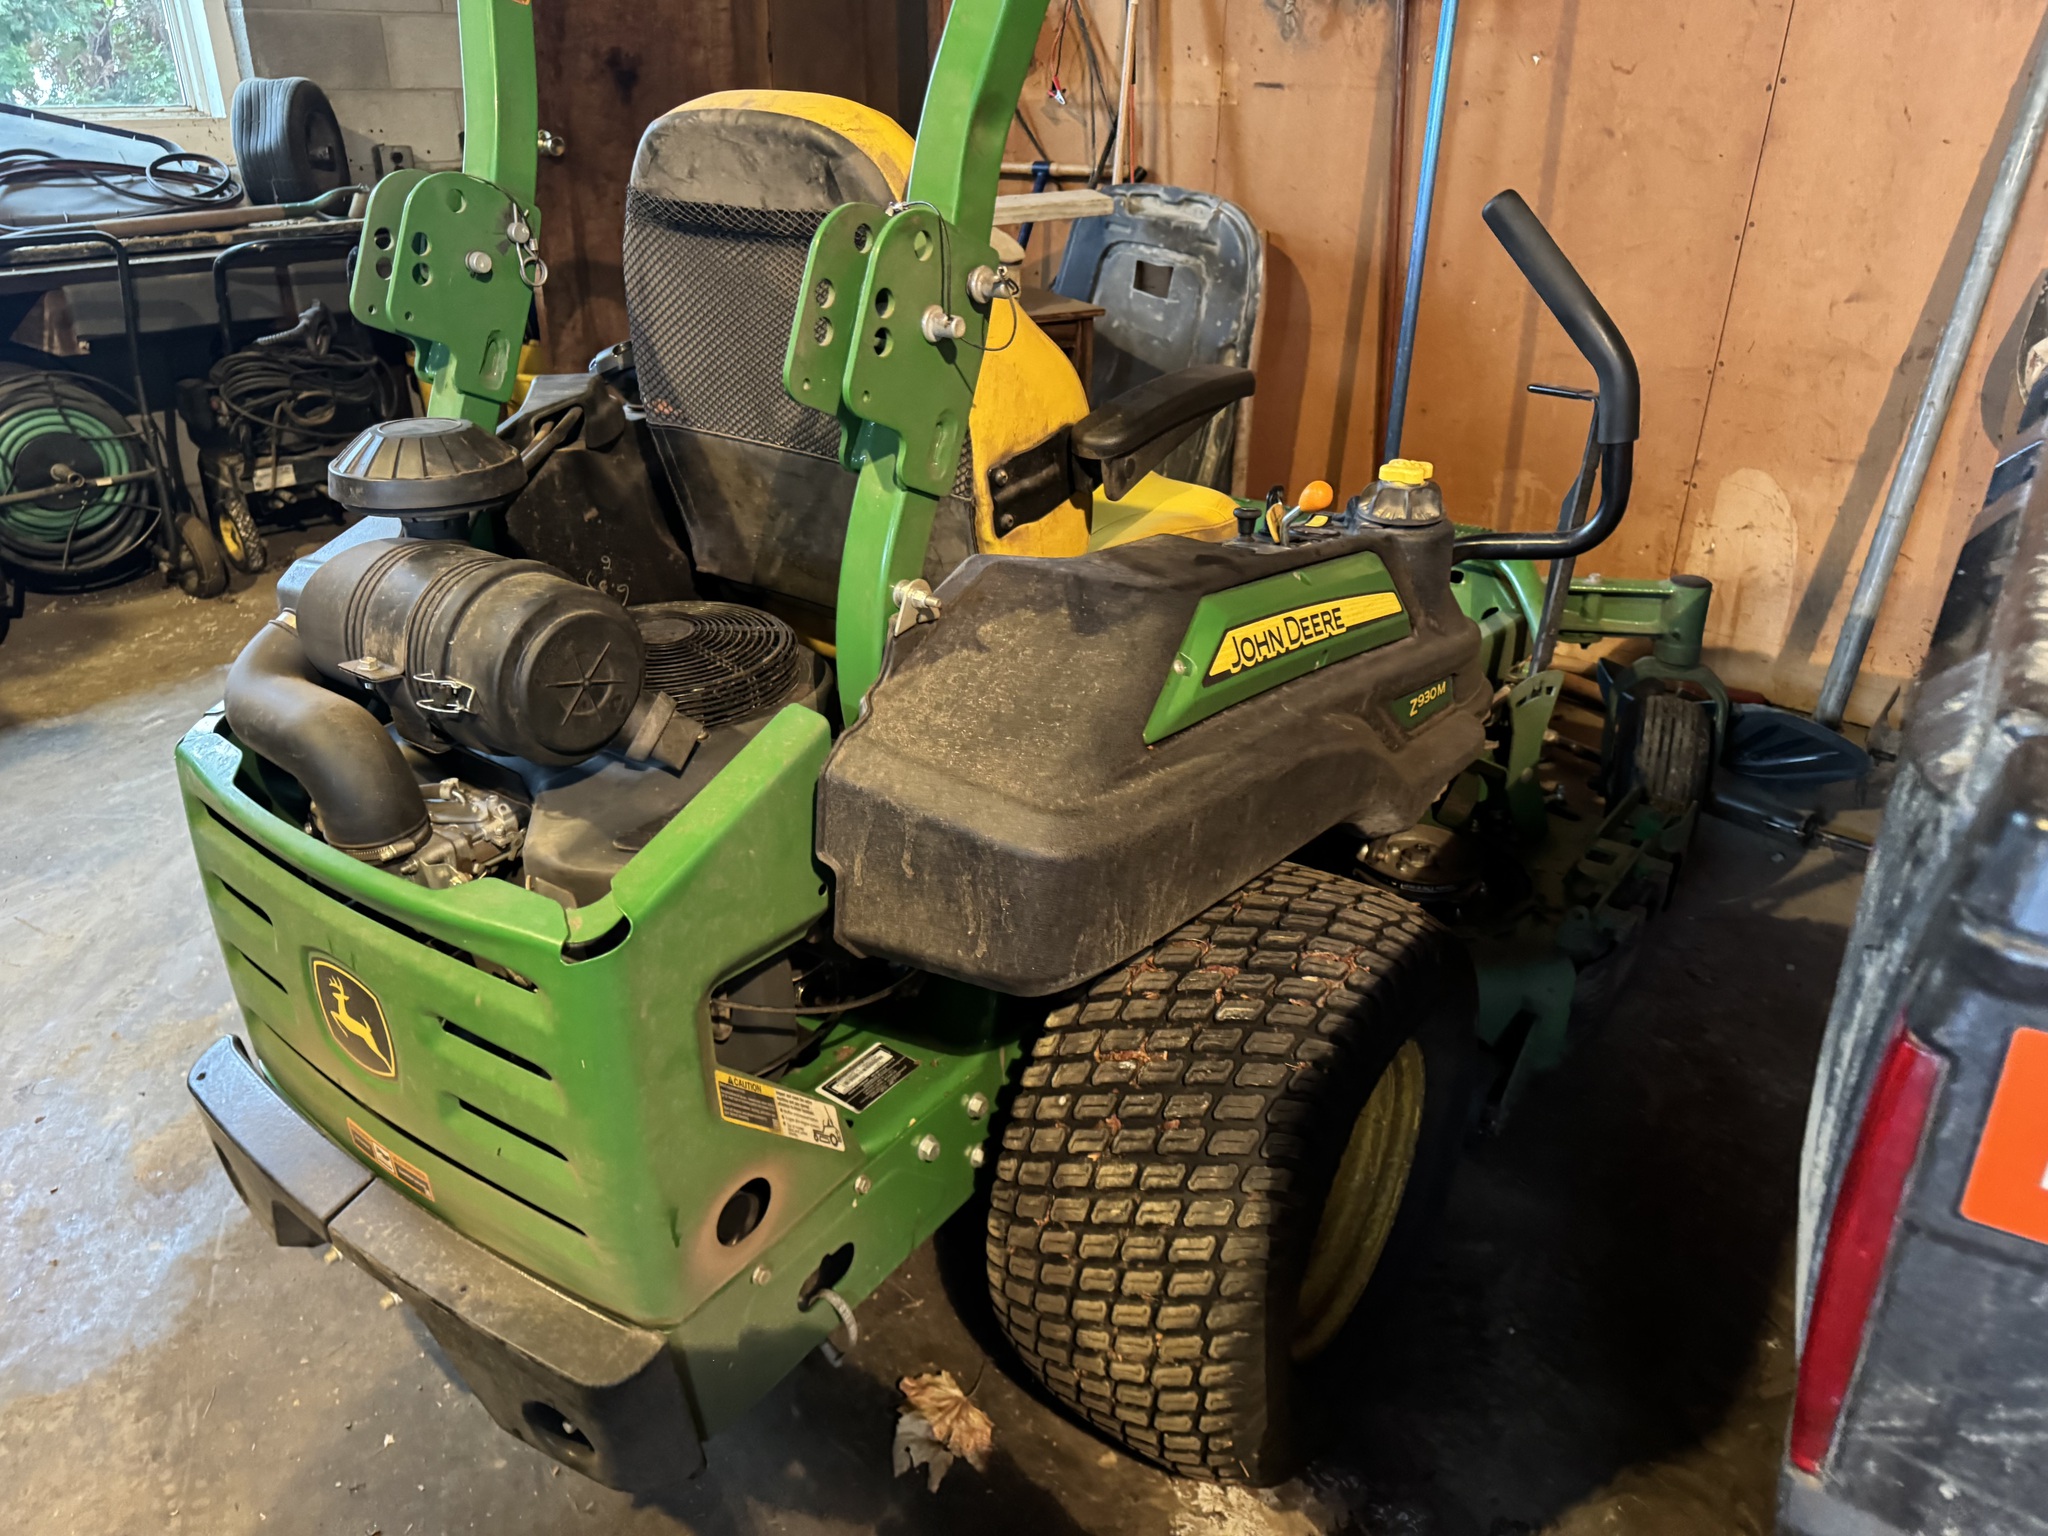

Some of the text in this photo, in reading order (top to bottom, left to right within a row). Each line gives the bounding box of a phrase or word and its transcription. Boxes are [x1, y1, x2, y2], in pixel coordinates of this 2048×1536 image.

[1231, 607, 1345, 668] JOHN DEERE
[1409, 680, 1447, 718] Z930M
[733, 1078, 762, 1093] CAUTION
